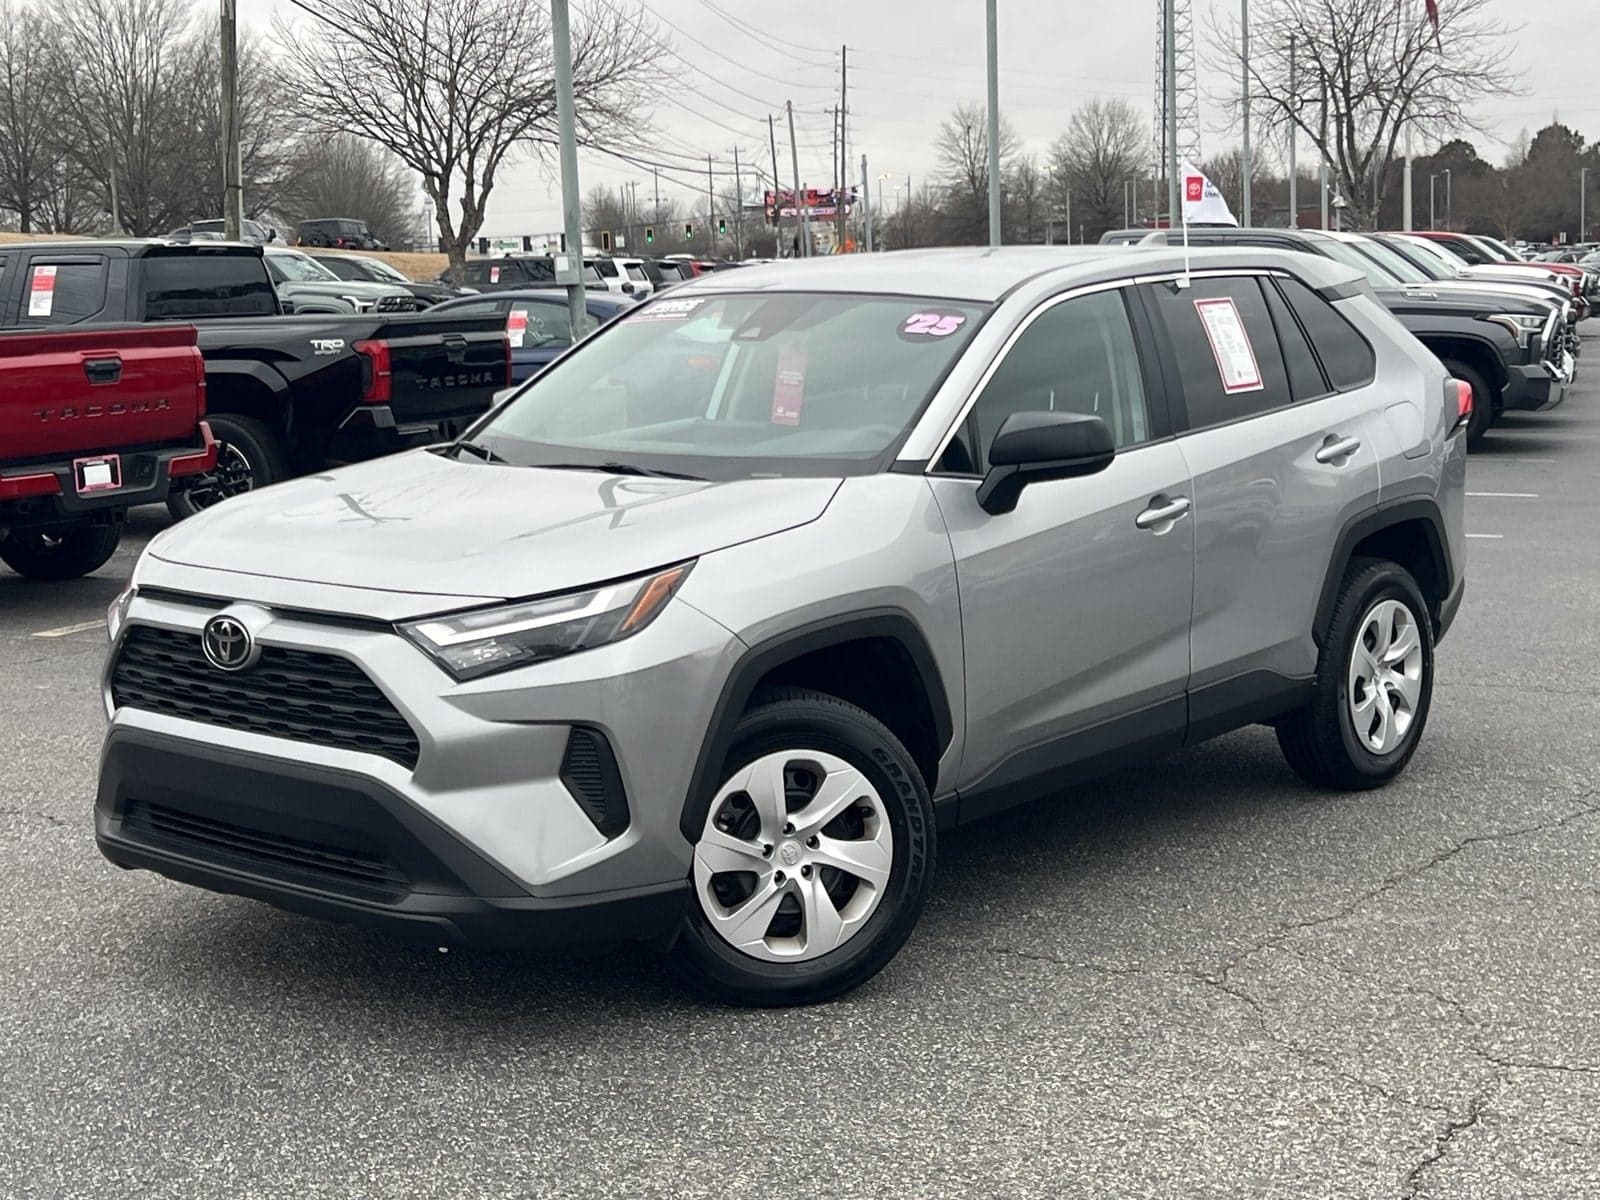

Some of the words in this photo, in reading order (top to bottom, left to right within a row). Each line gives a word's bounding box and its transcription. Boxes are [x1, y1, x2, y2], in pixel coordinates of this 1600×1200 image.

[310, 339, 344, 350] TRD
[415, 371, 493, 390] TACOMA
[34, 399, 171, 422] TACOMA
[871, 747, 925, 899] GRANDTRE
